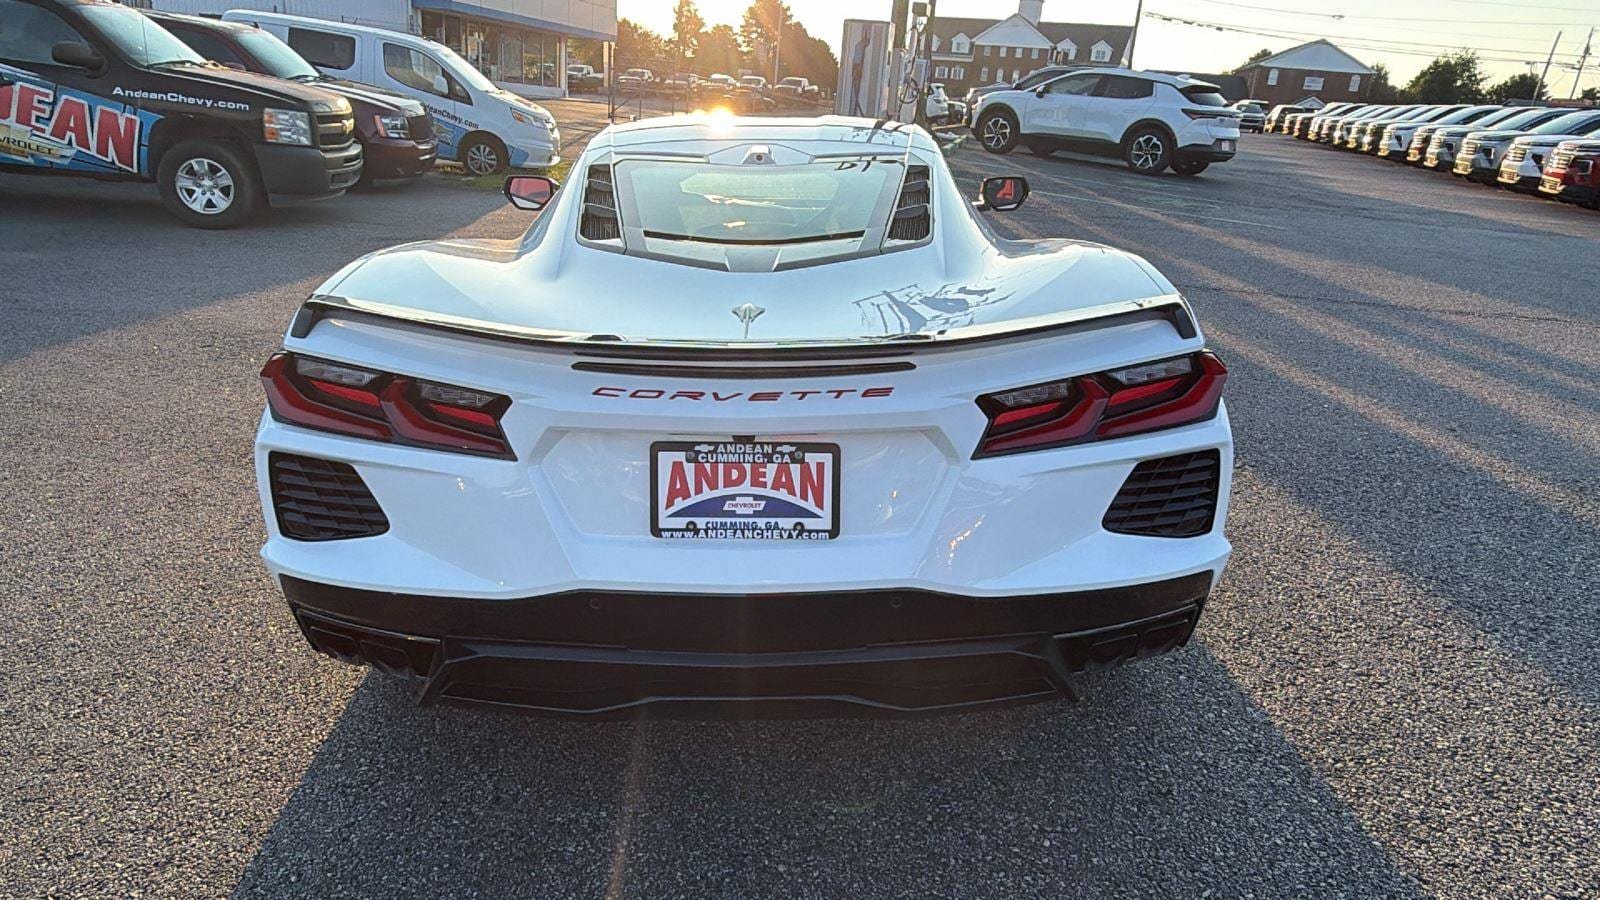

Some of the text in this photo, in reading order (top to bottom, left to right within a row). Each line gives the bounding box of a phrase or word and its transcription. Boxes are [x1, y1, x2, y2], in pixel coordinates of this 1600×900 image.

[112, 86, 249, 111] AndeanChevy.com
[592, 386, 895, 402] CORVETTE
[716, 444, 773, 453] ANDEAN
[698, 453, 791, 464] CUMMING, GA
[665, 460, 825, 512] ANDEAN
[661, 529, 829, 540] www.ANDEANCHEVY.com
